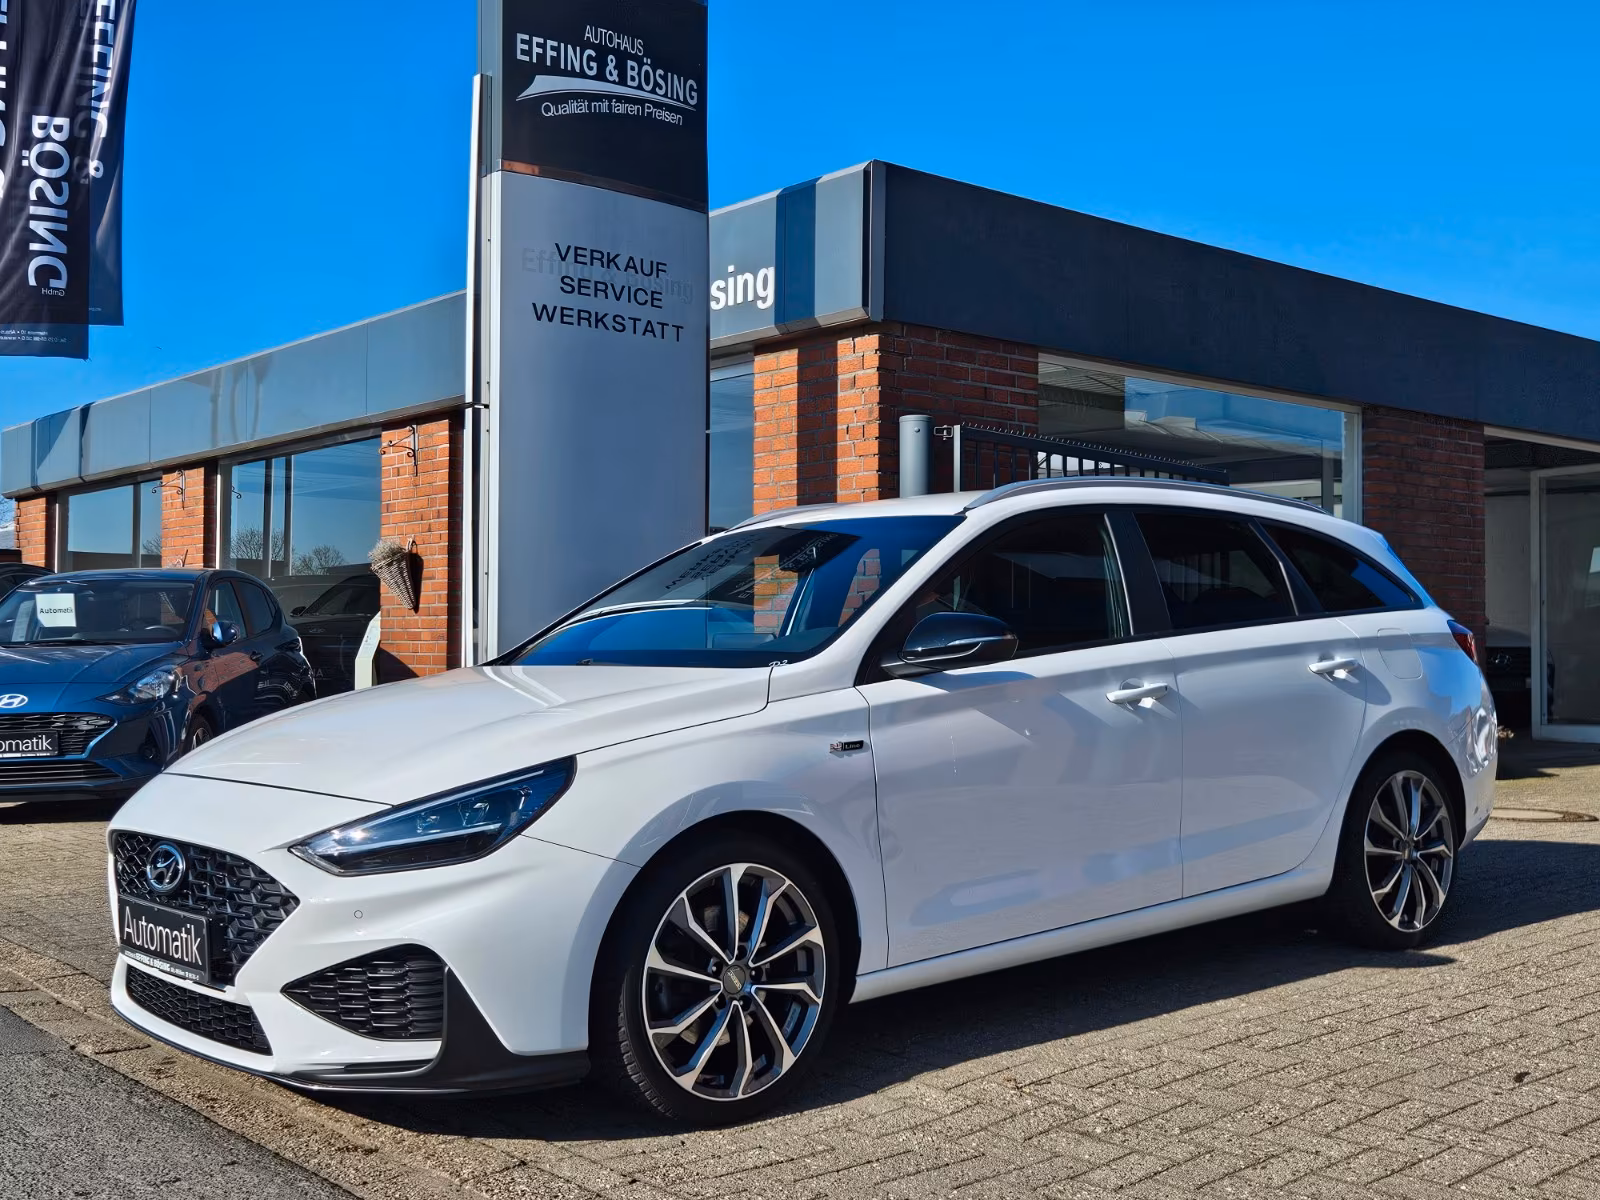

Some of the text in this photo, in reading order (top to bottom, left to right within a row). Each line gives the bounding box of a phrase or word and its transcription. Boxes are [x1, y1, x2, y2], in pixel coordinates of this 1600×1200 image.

[584, 25, 644, 56] AUTOHAUS
[516, 33, 698, 105] EFFING & BÖSING
[541, 99, 683, 126] Qualität mit fairen Preisen
[554, 242, 668, 279] VERKAUF
[559, 275, 663, 309] SERVICE
[531, 302, 684, 342] WERKSTATT
[123, 905, 202, 966] Automatik
